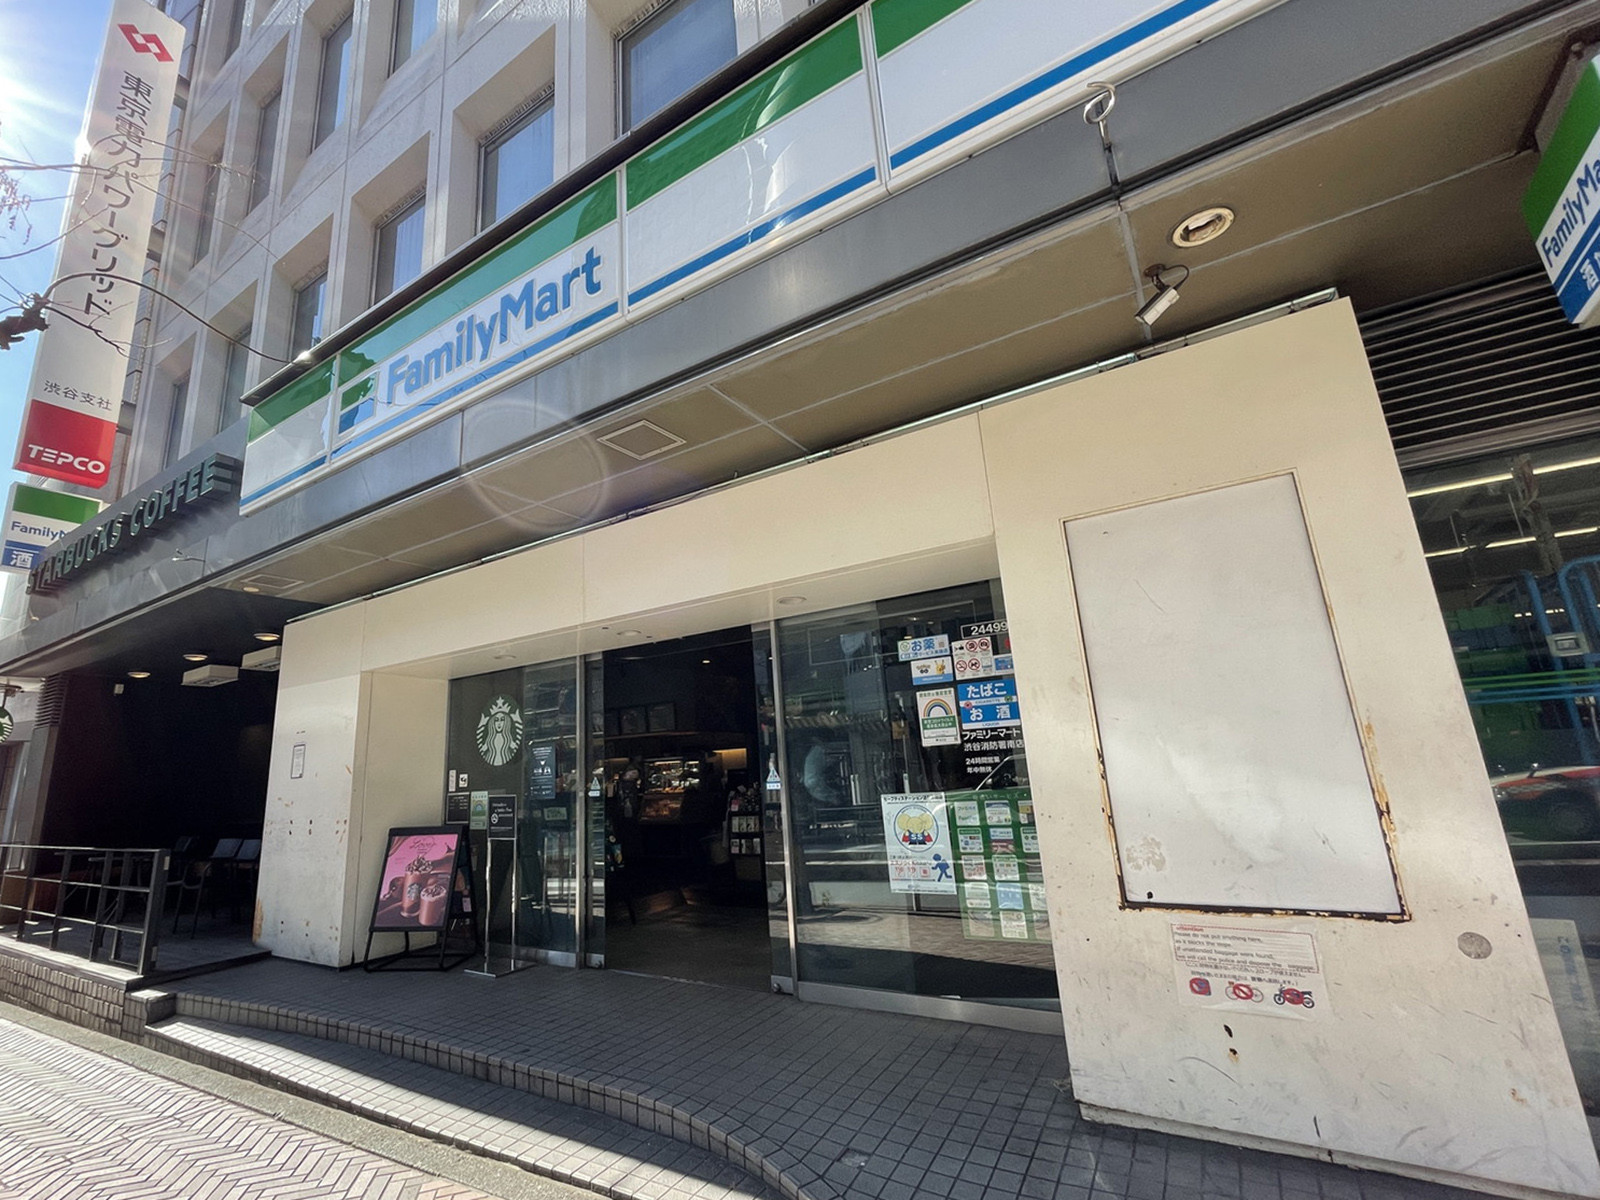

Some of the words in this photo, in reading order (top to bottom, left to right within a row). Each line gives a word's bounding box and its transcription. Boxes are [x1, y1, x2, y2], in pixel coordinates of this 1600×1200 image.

[84, 70, 154, 316] 東京電力パワーグリッド
[386, 246, 602, 406] FamilyMart
[43, 379, 112, 411] 渋谷支社
[28, 443, 106, 474] TEPCO
[25, 511, 127, 595] STARBUCKS
[130, 452, 220, 537] COFFEE
[10, 550, 34, 569] 酒
[970, 621, 1009, 636] 24499
[911, 638, 935, 651] お薬
[966, 682, 1007, 699] たばこ
[962, 727, 1020, 741] ファミリーマート
